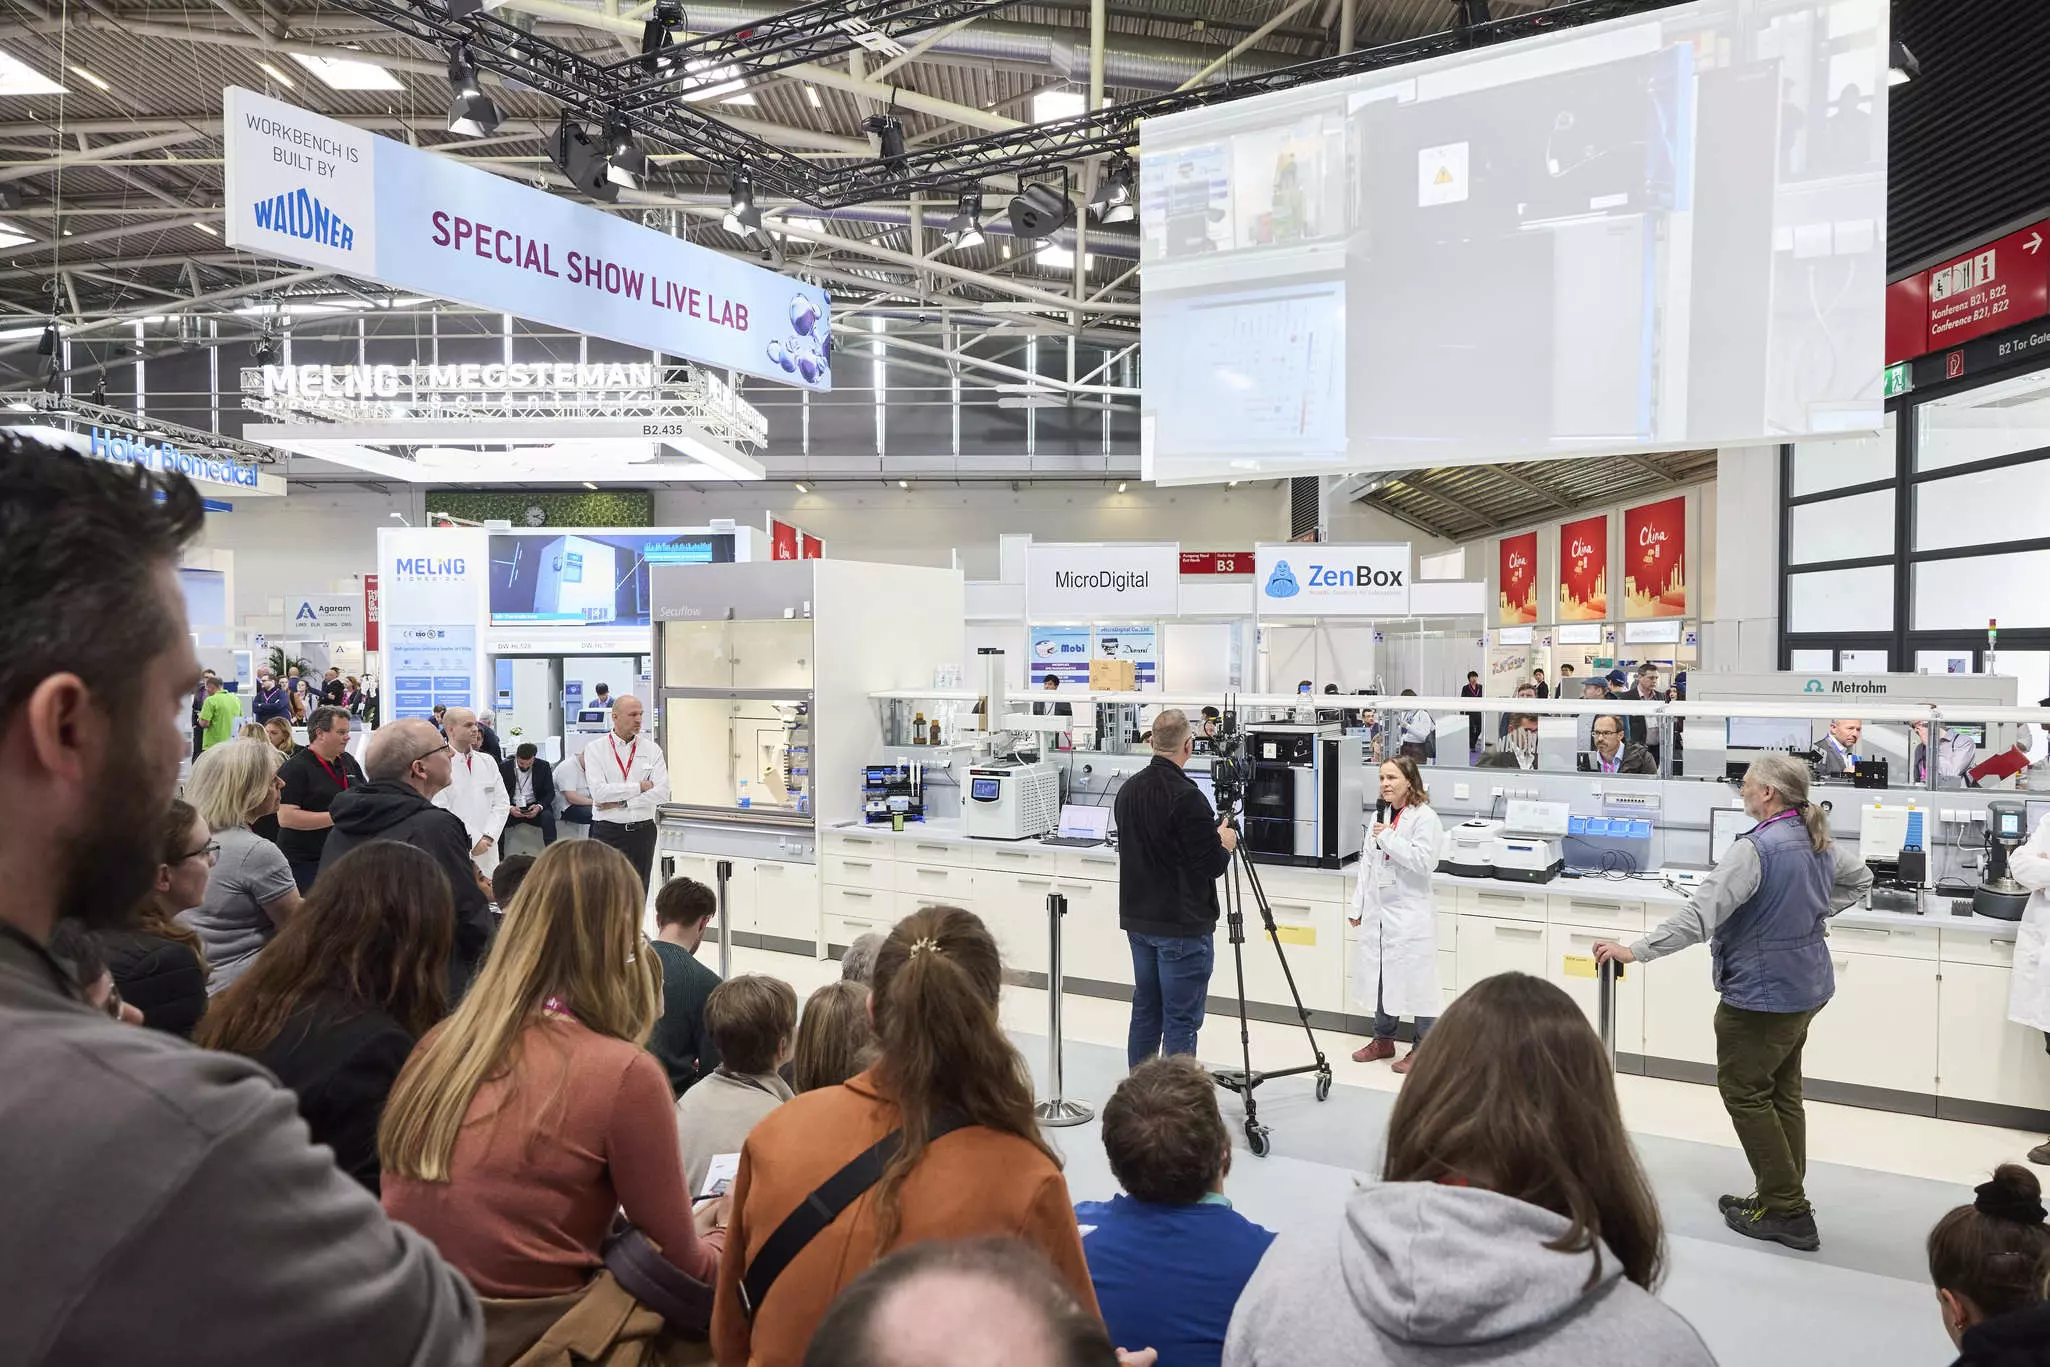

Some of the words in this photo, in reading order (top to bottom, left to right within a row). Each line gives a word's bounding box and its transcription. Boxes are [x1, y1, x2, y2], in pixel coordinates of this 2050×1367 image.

[246, 113, 342, 157] WORKBENCH
[346, 146, 359, 163] IS
[273, 146, 313, 172] BUILT
[318, 160, 336, 178] BY
[254, 187, 354, 251] WALDNER
[432, 210, 559, 278] SPECIAL
[567, 251, 644, 301] SHOW
[652, 276, 701, 319] LIVE
[708, 294, 749, 332] LAB
[1931, 301, 1968, 320] Konferenz
[1970, 292, 1988, 307] B21,
[1989, 284, 2007, 300] B22
[1931, 315, 1972, 335] Conference
[1973, 306, 1991, 321] B21,
[1992, 299, 2009, 315] B22
[1999, 342, 2012, 356] B2
[2013, 339, 2028, 351] Tor
[429, 362, 652, 388] MEGSTEMAN
[643, 424, 683, 435] B2.435
[91, 424, 156, 466] Haier
[161, 442, 258, 487] Biomedical
[1640, 522, 1669, 546] China
[1571, 537, 1593, 557] China
[1217, 560, 1234, 571] B3
[1509, 551, 1527, 568] China
[1055, 570, 1149, 592] MicroDigital
[1308, 565, 1403, 587] ZenBox
[319, 605, 351, 614] Agaram
[660, 605, 701, 617] Secuflow
[1061, 644, 1085, 653] Mobi
[1832, 680, 1887, 693] Metrohm
